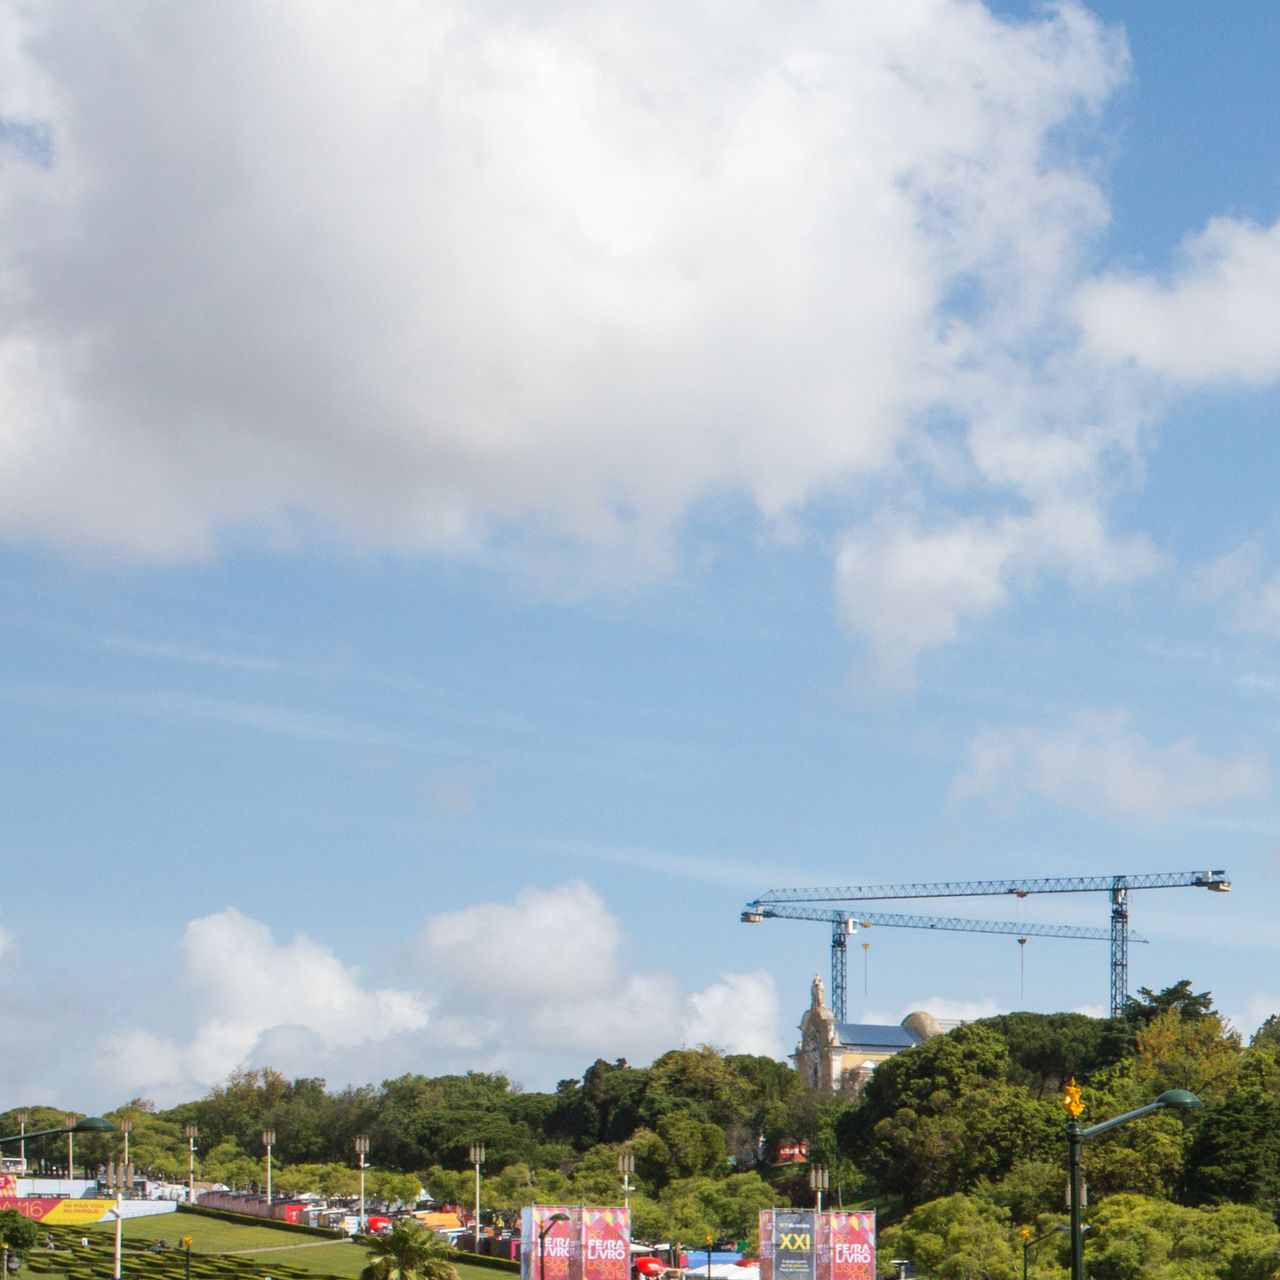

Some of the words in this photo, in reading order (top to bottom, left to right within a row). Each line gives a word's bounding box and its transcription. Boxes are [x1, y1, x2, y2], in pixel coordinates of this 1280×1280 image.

[588, 1239, 625, 1249] FEIRA
[780, 1233, 810, 1250] XXI
[835, 1244, 870, 1253] FEIRA
[587, 1249, 626, 1260] LIVRO
[835, 1253, 871, 1264] LIVRO
